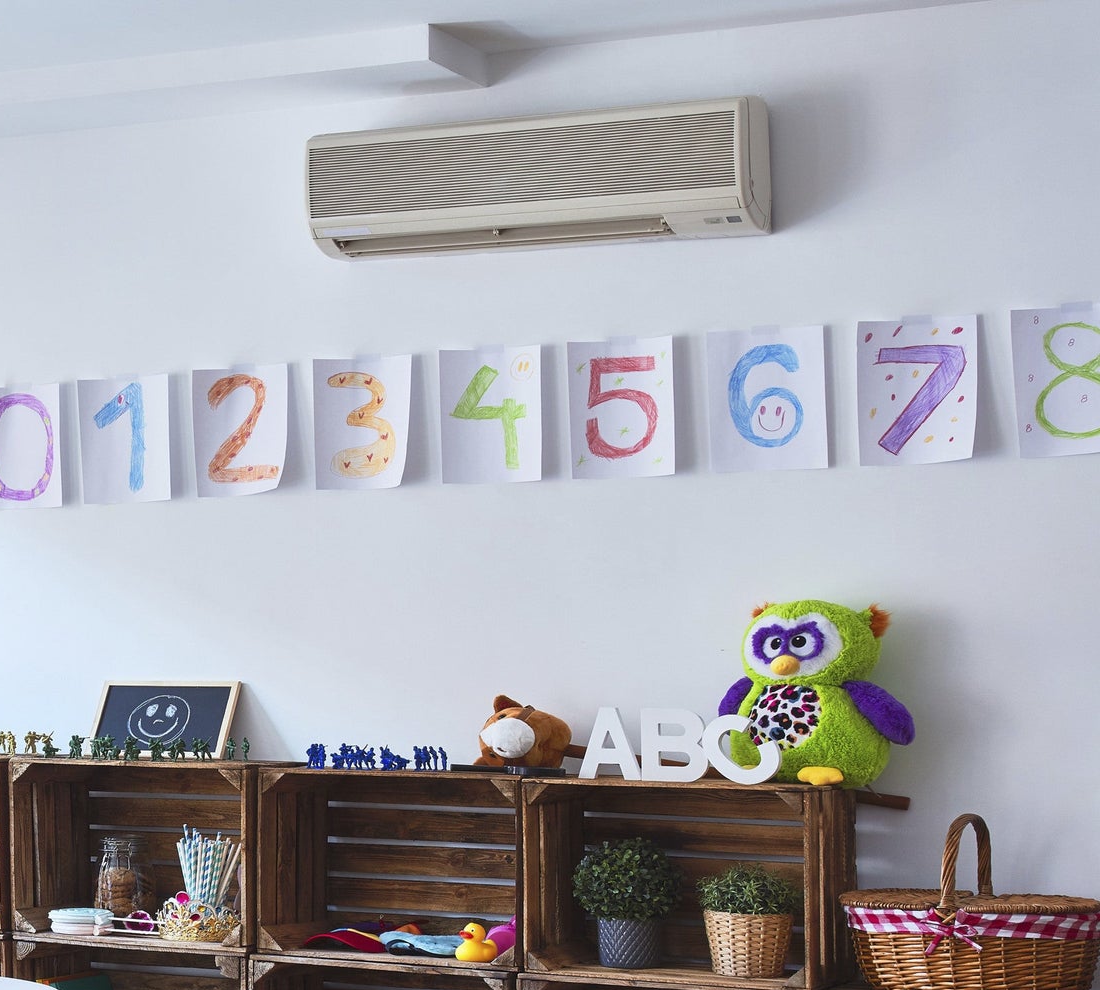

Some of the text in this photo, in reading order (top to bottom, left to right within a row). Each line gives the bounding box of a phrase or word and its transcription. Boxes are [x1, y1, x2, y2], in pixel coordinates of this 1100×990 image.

[206, 373, 280, 483] 2
[326, 371, 395, 479] 3
[449, 363, 527, 470] 4
[584, 355, 659, 460] 5
[727, 343, 804, 448] 6
[873, 344, 967, 456] 7
[1035, 321, 1100, 438] 8
[92, 381, 145, 493] 1
[578, 706, 782, 785] ABC
